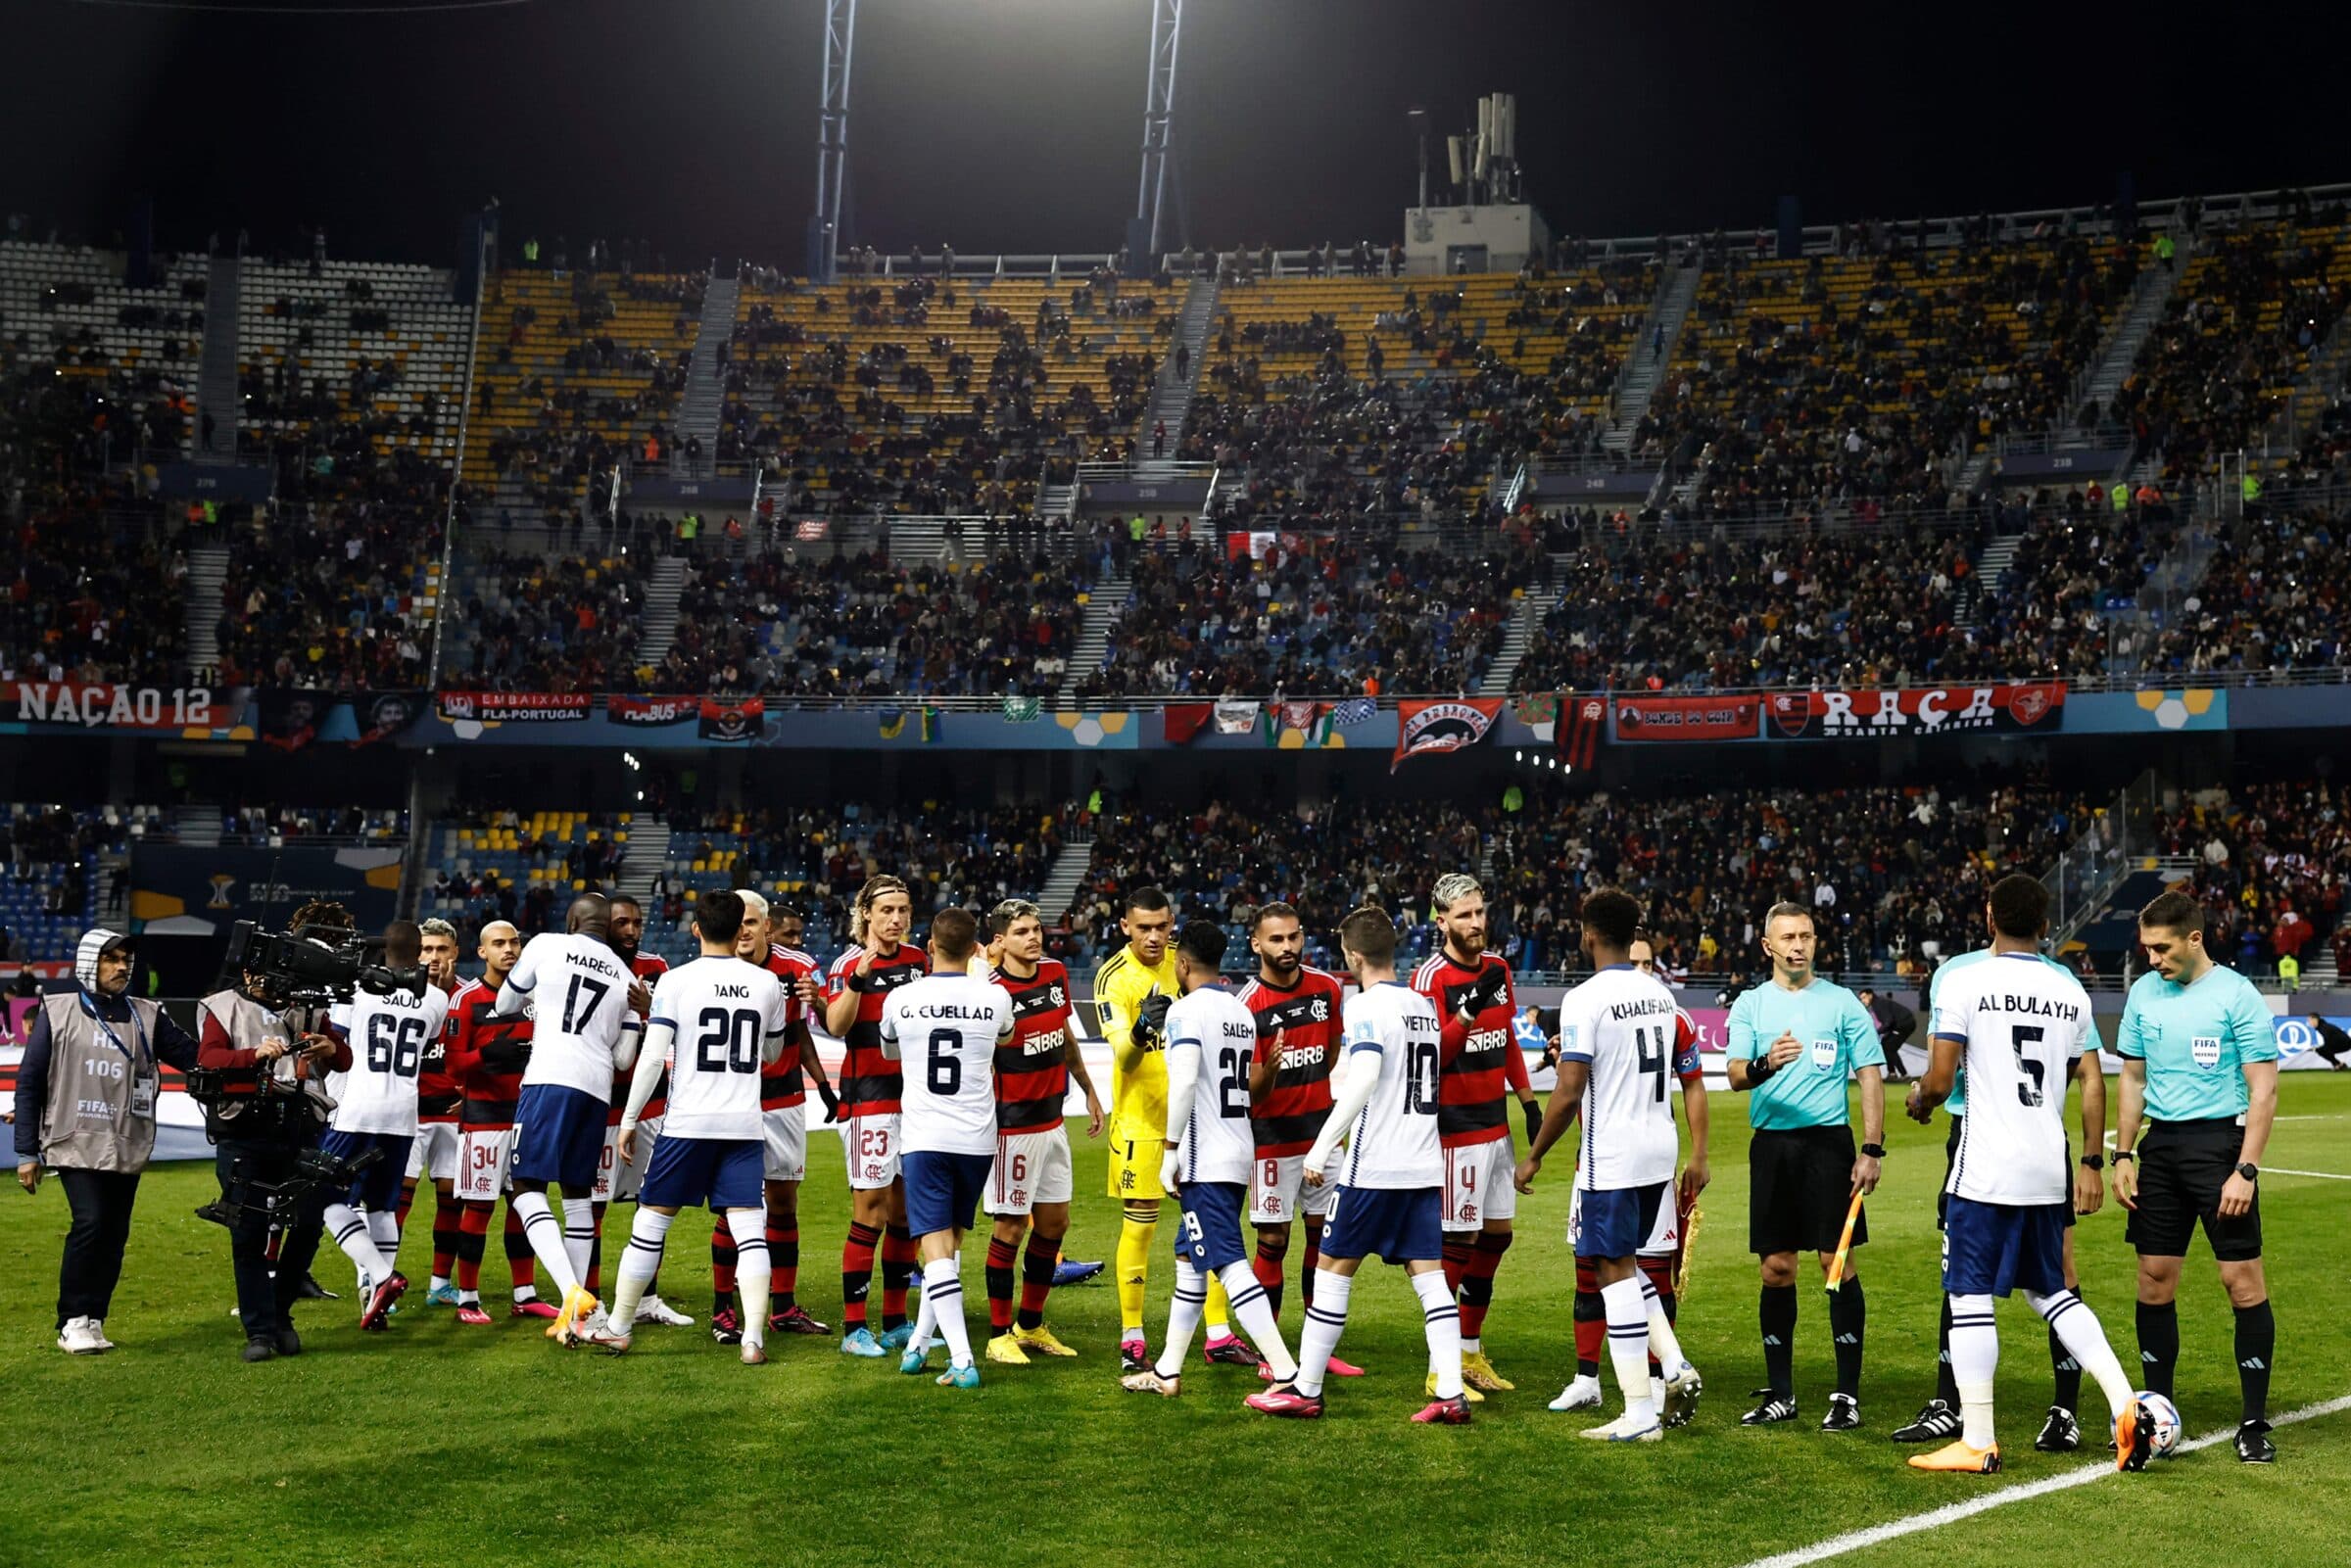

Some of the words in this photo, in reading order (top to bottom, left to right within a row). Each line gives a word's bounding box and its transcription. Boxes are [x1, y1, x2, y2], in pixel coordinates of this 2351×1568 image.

[172, 689, 211, 724] 12
[482, 694, 585, 705] EMBAIXADA
[482, 709, 583, 720] FLA-PORTUGAL
[1844, 727, 1898, 736] SANTA
[566, 952, 620, 980] MAREGA
[382, 993, 423, 1010] SAUD
[561, 974, 609, 1035] 17
[900, 1005, 914, 1019] G.
[919, 1005, 994, 1021] CUELLAR
[1611, 998, 1673, 1021] KHALIFAH
[1978, 996, 2001, 1012] AL
[2004, 995, 2078, 1022] BULAYHI
[697, 1008, 761, 1073] 20
[1041, 1027, 1065, 1052] BRB
[1223, 1022, 1254, 1039] SALEM
[1483, 1028, 1507, 1051] BRB
[2194, 1039, 2217, 1048] FIFA
[368, 1013, 426, 1077] 66
[1294, 1045, 1323, 1068] BRB
[1815, 1042, 1834, 1051] FIFA
[85, 1059, 122, 1079] 106
[928, 1028, 963, 1095] 6
[1636, 1026, 1663, 1103] 4
[2012, 1025, 2044, 1108] 5
[1220, 1048, 1252, 1118] 29
[1404, 1042, 1438, 1115] 10
[861, 1130, 888, 1157] 23
[474, 1146, 498, 1169] 34
[1013, 1155, 1026, 1181] 6
[1264, 1159, 1278, 1187] 8
[1462, 1165, 1475, 1193] 4
